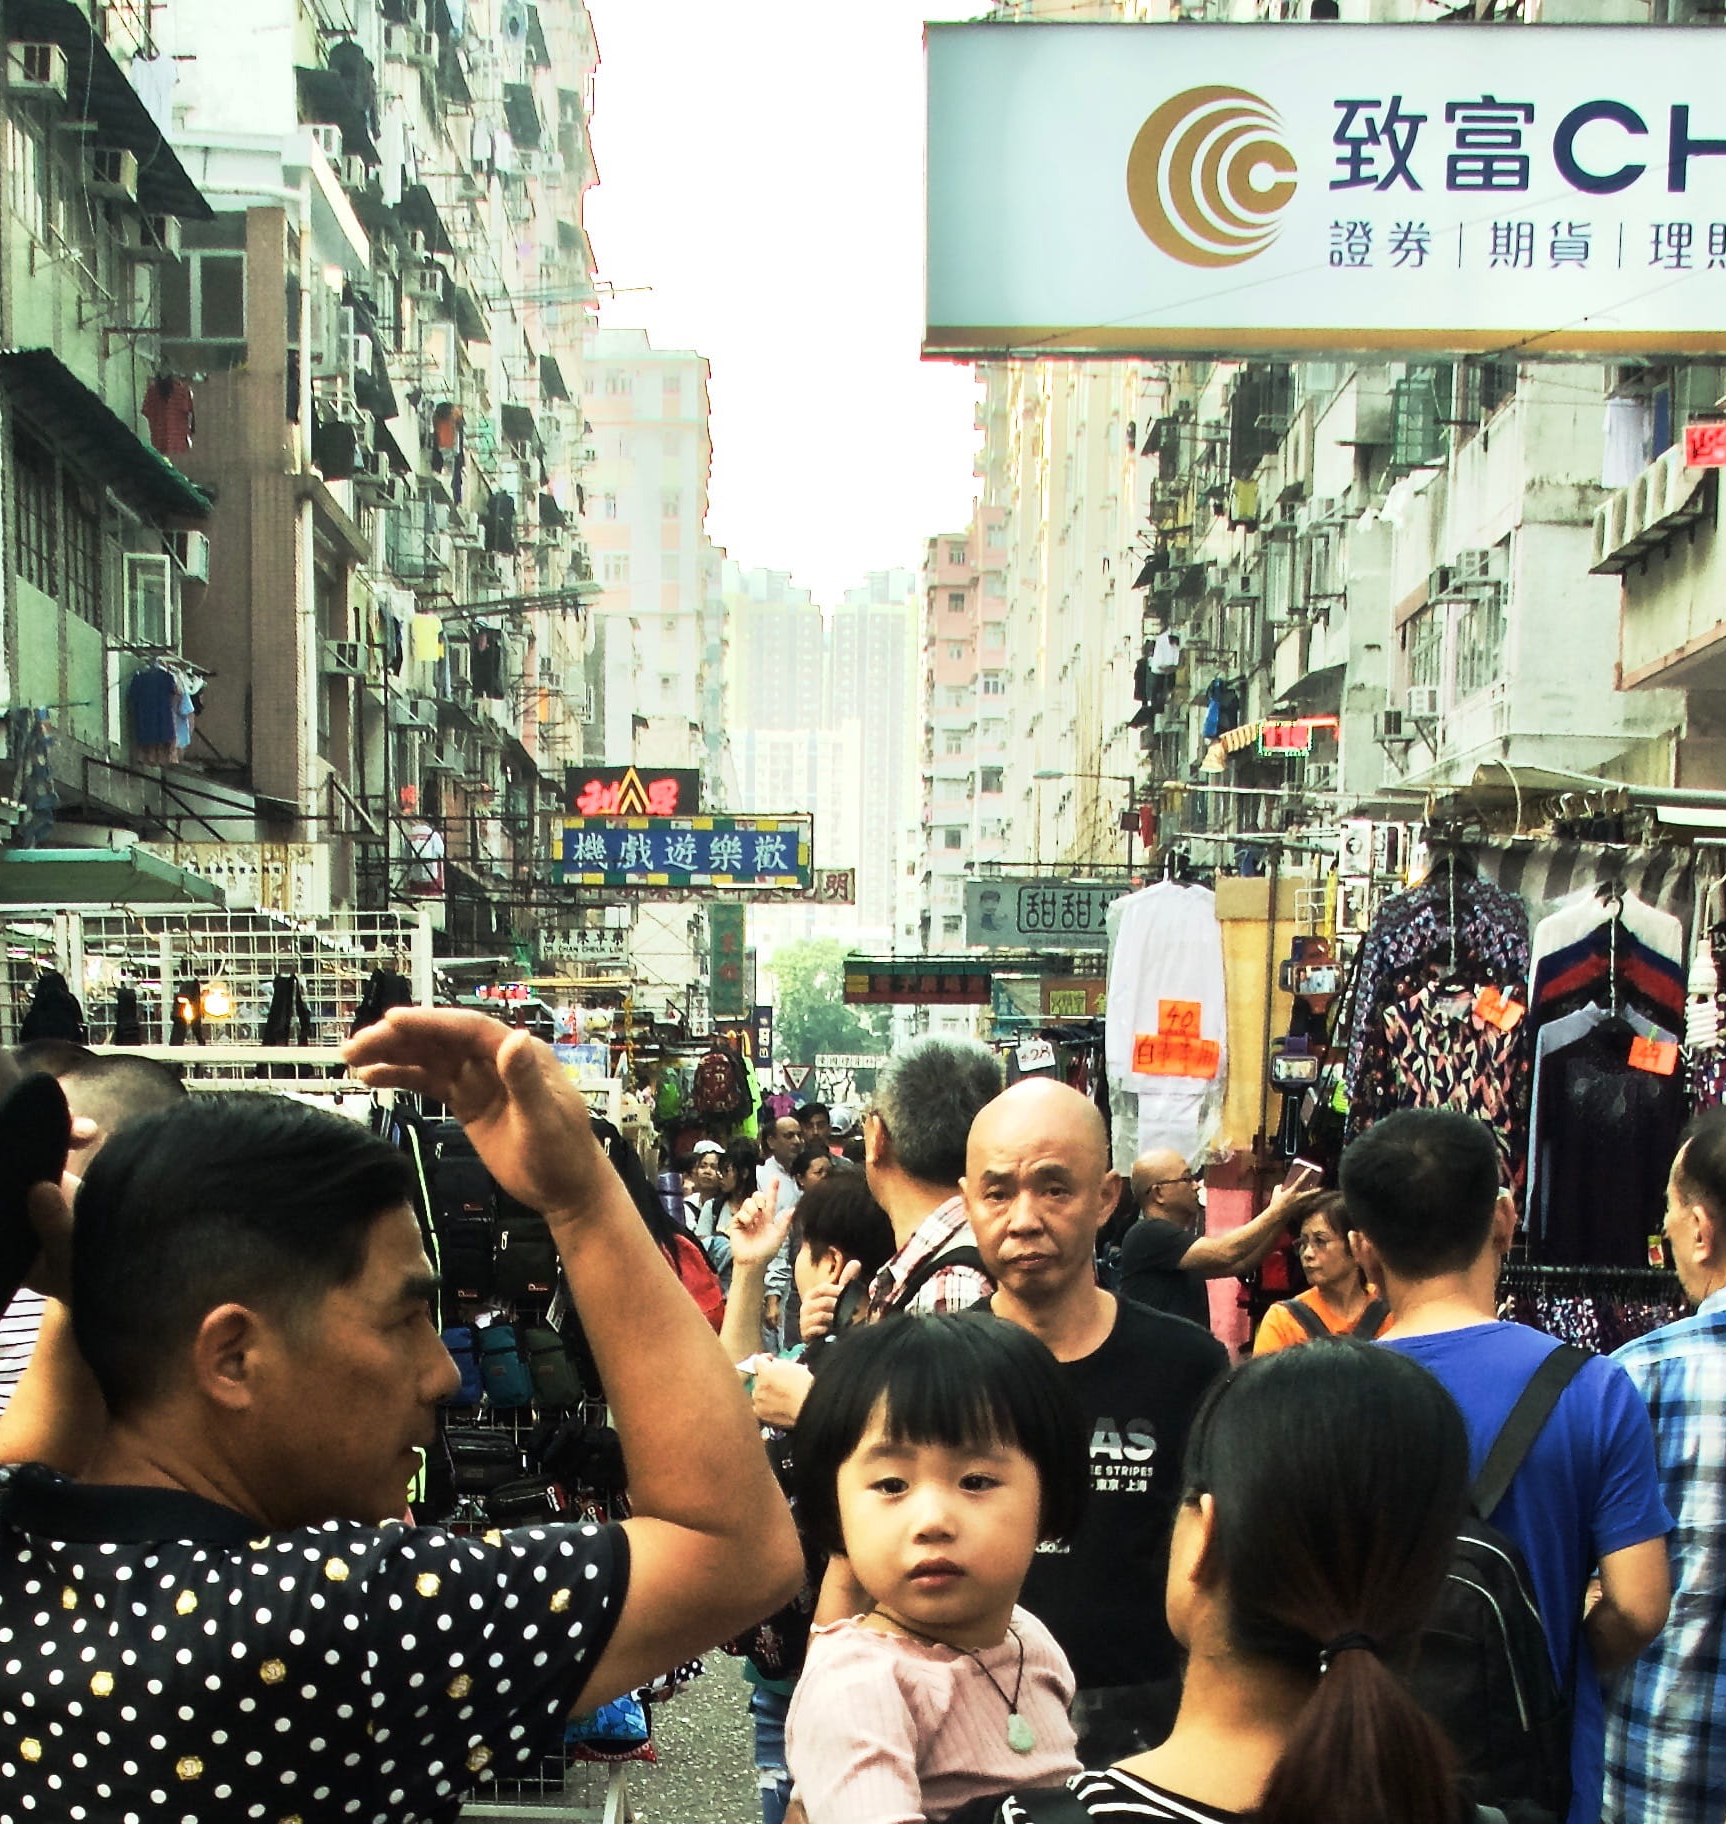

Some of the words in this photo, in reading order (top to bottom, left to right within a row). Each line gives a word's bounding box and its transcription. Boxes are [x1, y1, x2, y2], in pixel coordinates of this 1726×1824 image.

[1328, 95, 1536, 193] 致富
[1330, 219, 1433, 270] 證券
[1488, 219, 1594, 270] 期貨
[1089, 1416, 1157, 1461] AS
[1105, 1465, 1153, 1477] STRIPES
